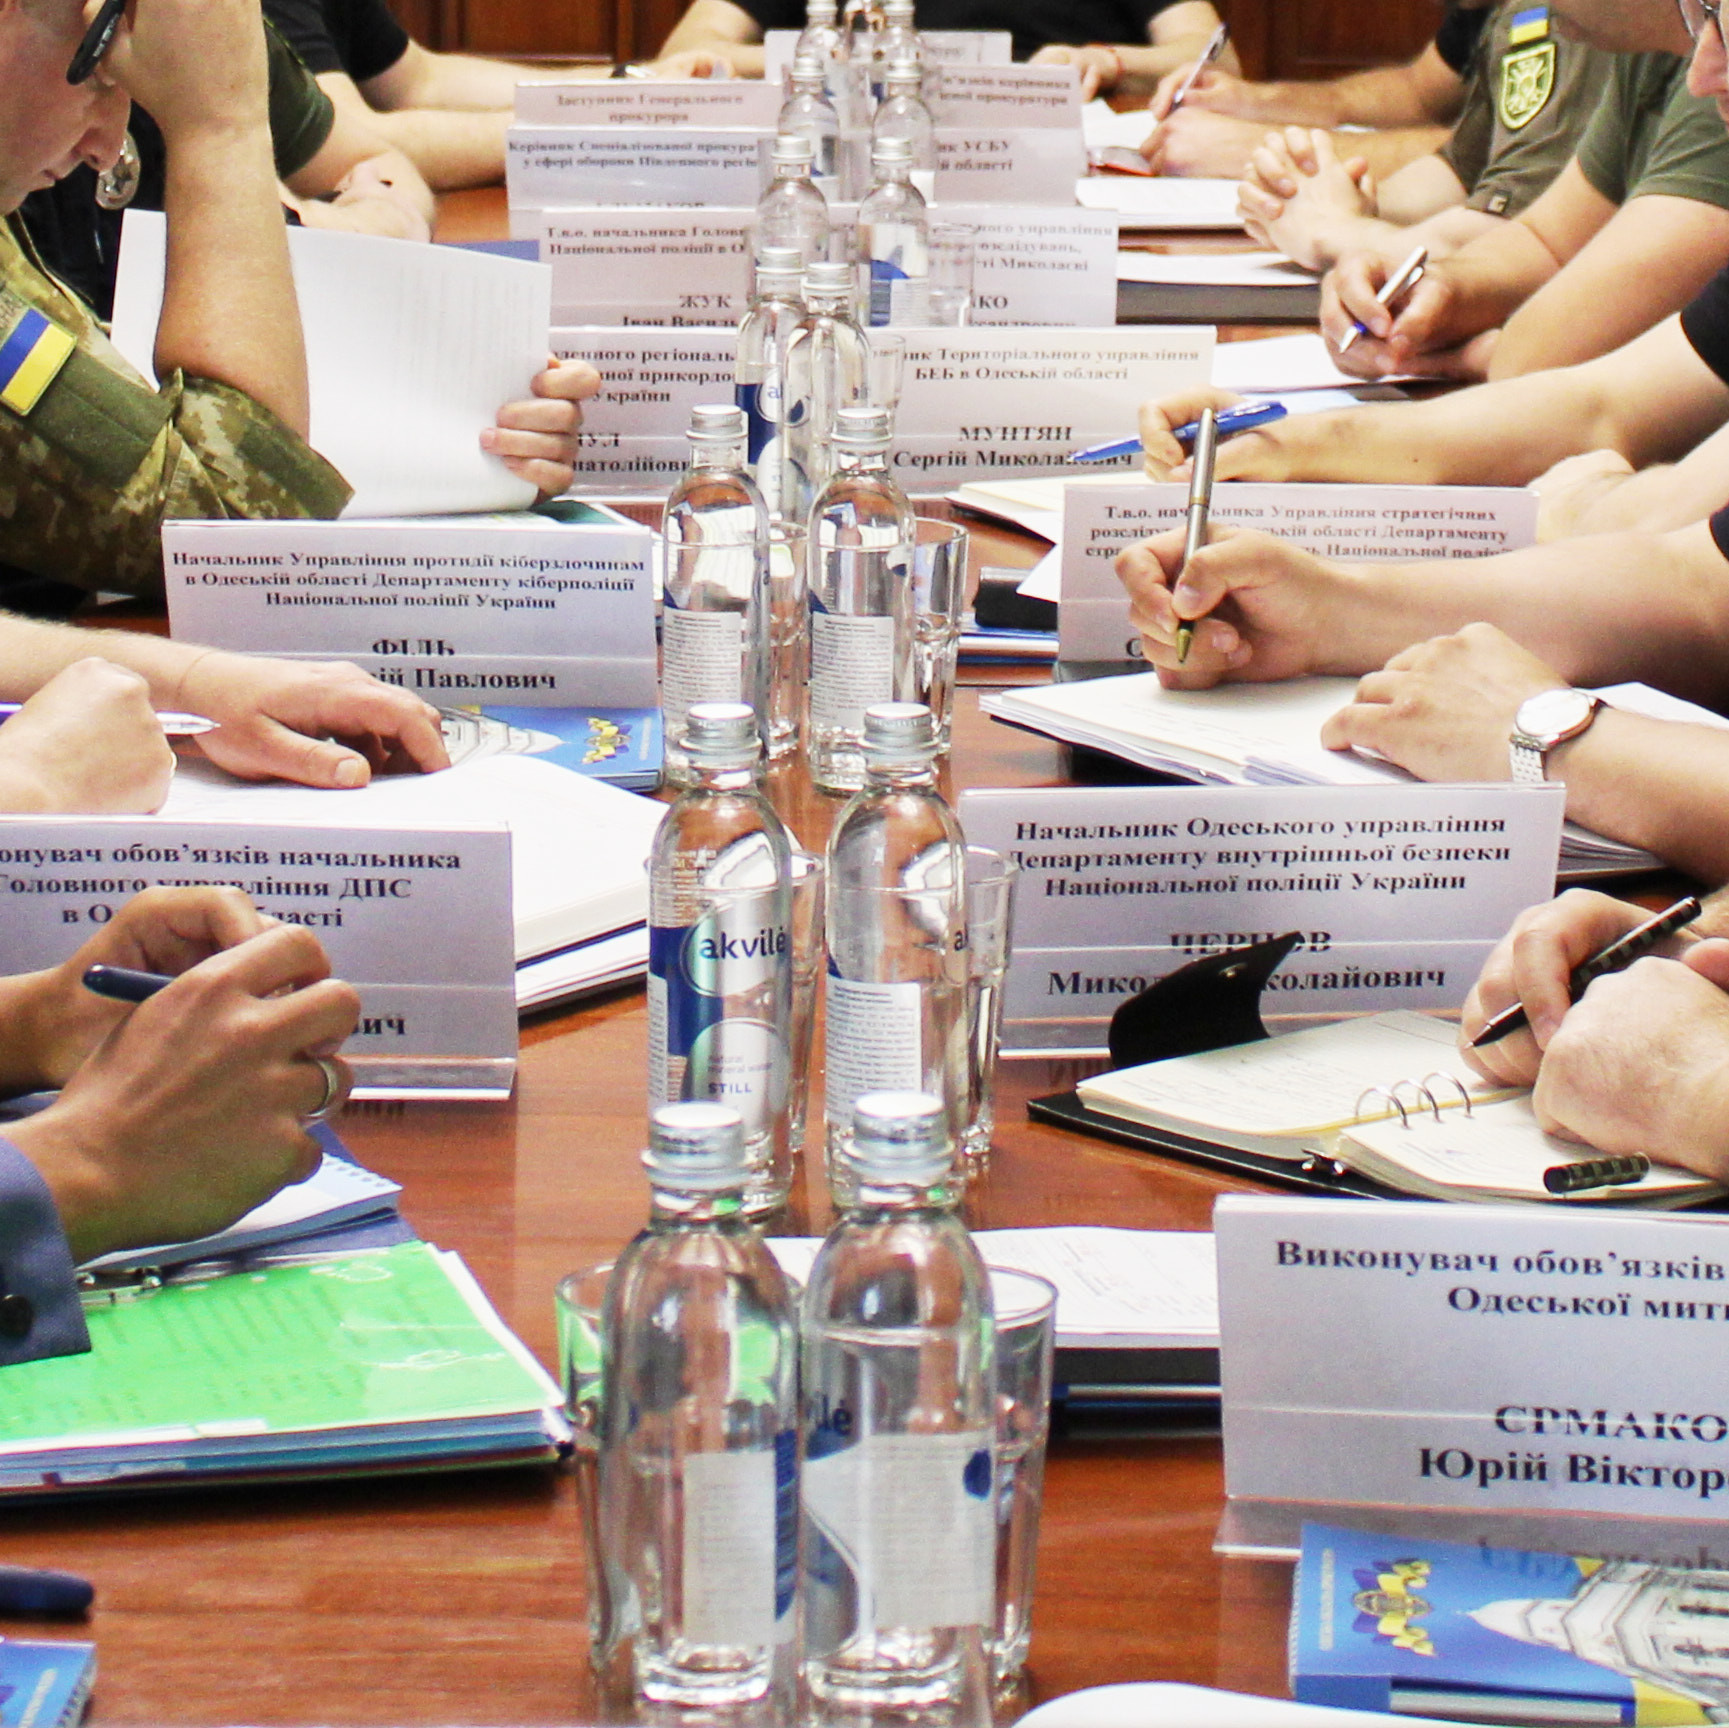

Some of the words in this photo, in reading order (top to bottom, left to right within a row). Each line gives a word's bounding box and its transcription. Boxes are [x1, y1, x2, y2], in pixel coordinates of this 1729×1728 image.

[679, 295, 731, 308] ЖУК
[916, 368, 954, 380] БЕБ
[959, 427, 1072, 441] МУНТЯН
[894, 451, 966, 467] Сергій
[173, 552, 284, 567] Начальник
[291, 553, 406, 569] Управління
[414, 553, 494, 569] протидії
[501, 556, 644, 572] кіберзлочинам
[186, 576, 195, 586] в
[203, 572, 289, 588] Одеській
[298, 573, 367, 588] області
[375, 574, 511, 591] Департаменту
[518, 576, 634, 591] кіберполіції
[266, 593, 397, 607] Національної
[404, 594, 468, 608] поліції
[476, 594, 556, 610] України
[414, 668, 556, 689] Павлович
[1016, 819, 1178, 841] Начальник
[1187, 817, 1334, 839] Одеського
[1344, 816, 1506, 838] управління
[280, 847, 461, 871] начальника
[1217, 846, 1396, 866] внутрішньої
[1402, 845, 1510, 864] безпеки
[340, 877, 411, 901] ДПС
[1045, 874, 1238, 897] Національної
[1247, 874, 1341, 895] поліції
[1351, 873, 1466, 893] України
[62, 908, 78, 924] в
[699, 926, 787, 959] akvilė
[708, 1083, 752, 1095] STILL
[1276, 1240, 1498, 1272] Виконувач
[1447, 1287, 1631, 1316] Одеської
[1420, 1447, 1548, 1489] Юрій
